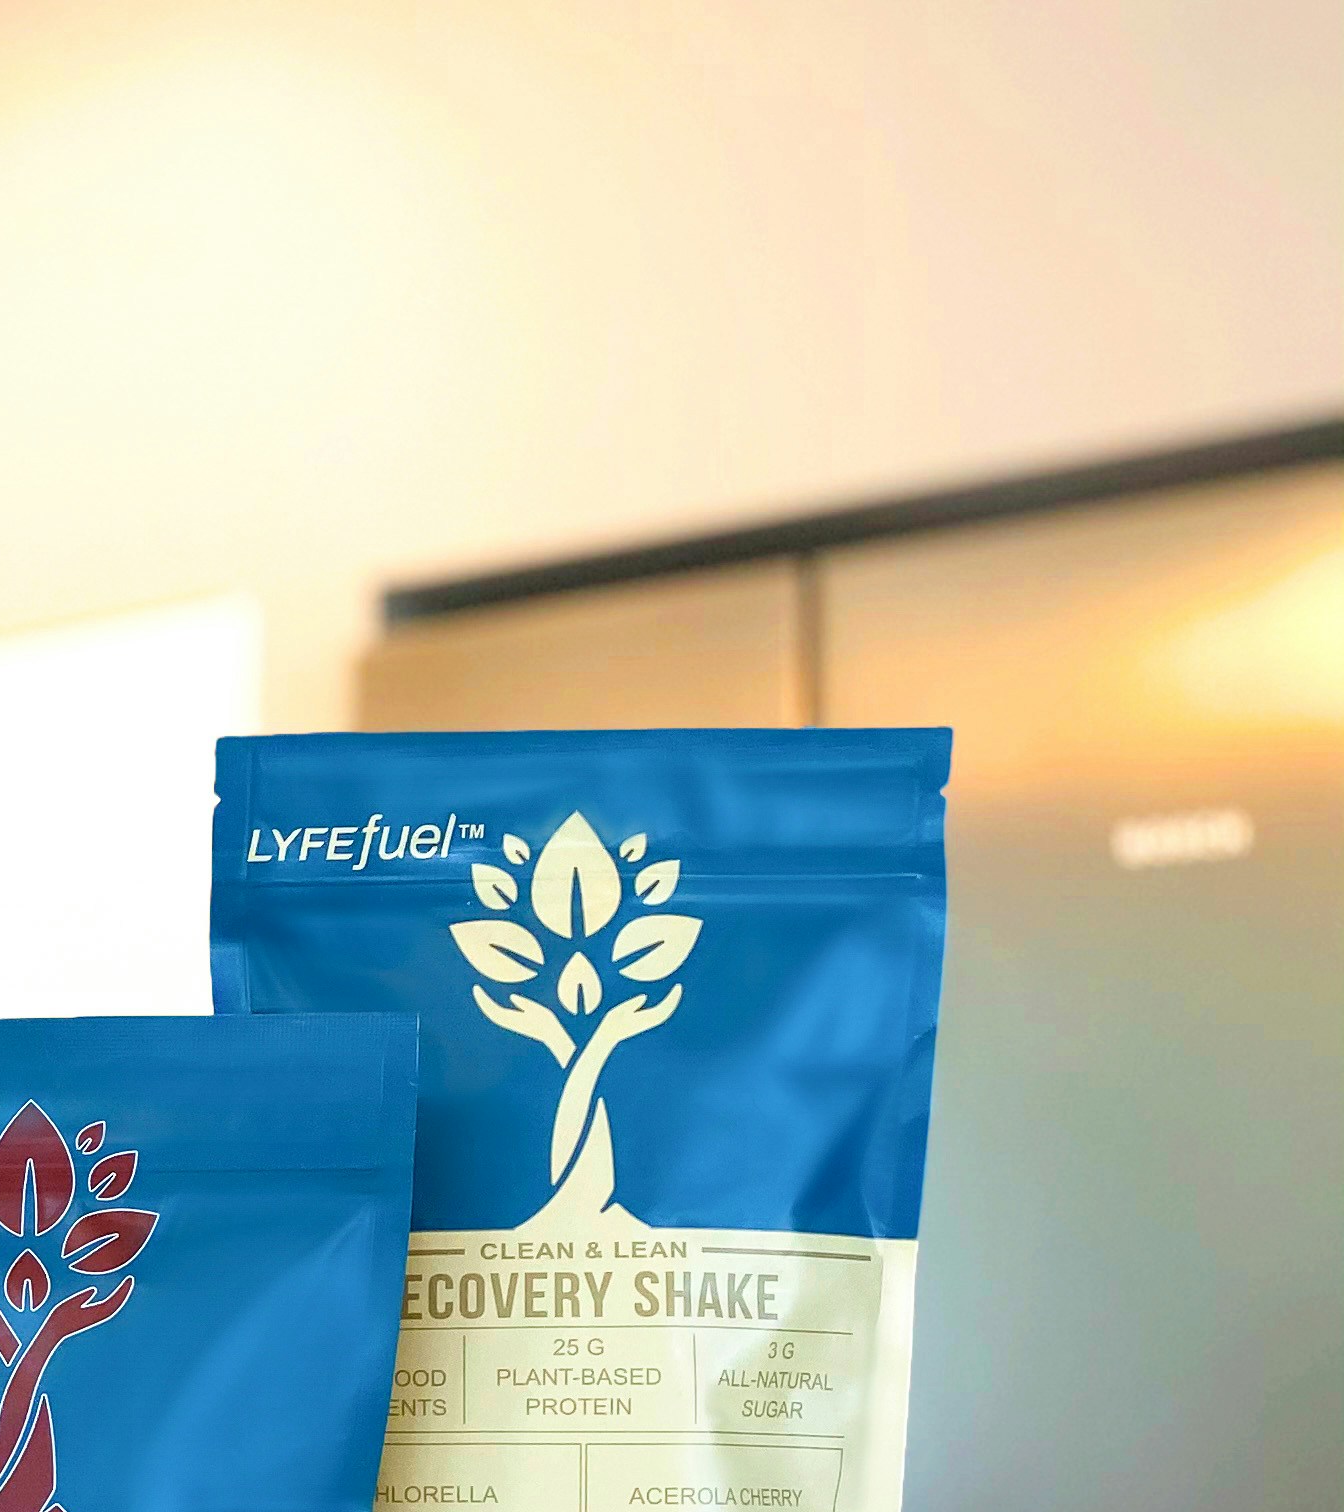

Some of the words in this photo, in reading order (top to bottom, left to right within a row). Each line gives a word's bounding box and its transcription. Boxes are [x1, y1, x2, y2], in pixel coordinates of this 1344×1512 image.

[480, 1242, 574, 1260] CLEAN
[586, 1242, 602, 1258] &
[614, 1241, 686, 1258] LEAN
[635, 1271, 778, 1320] SHAKE
[553, 1339, 578, 1355] 25
[588, 1338, 604, 1355] G
[497, 1368, 661, 1386] PLANT-BASED
[718, 1370, 833, 1391] ALL-NATURAL
[527, 1398, 631, 1415] PROTEIN
[742, 1400, 802, 1418] SUGAR
[629, 1487, 737, 1505] ACEROLA
[740, 1488, 802, 1507] CHERRY
